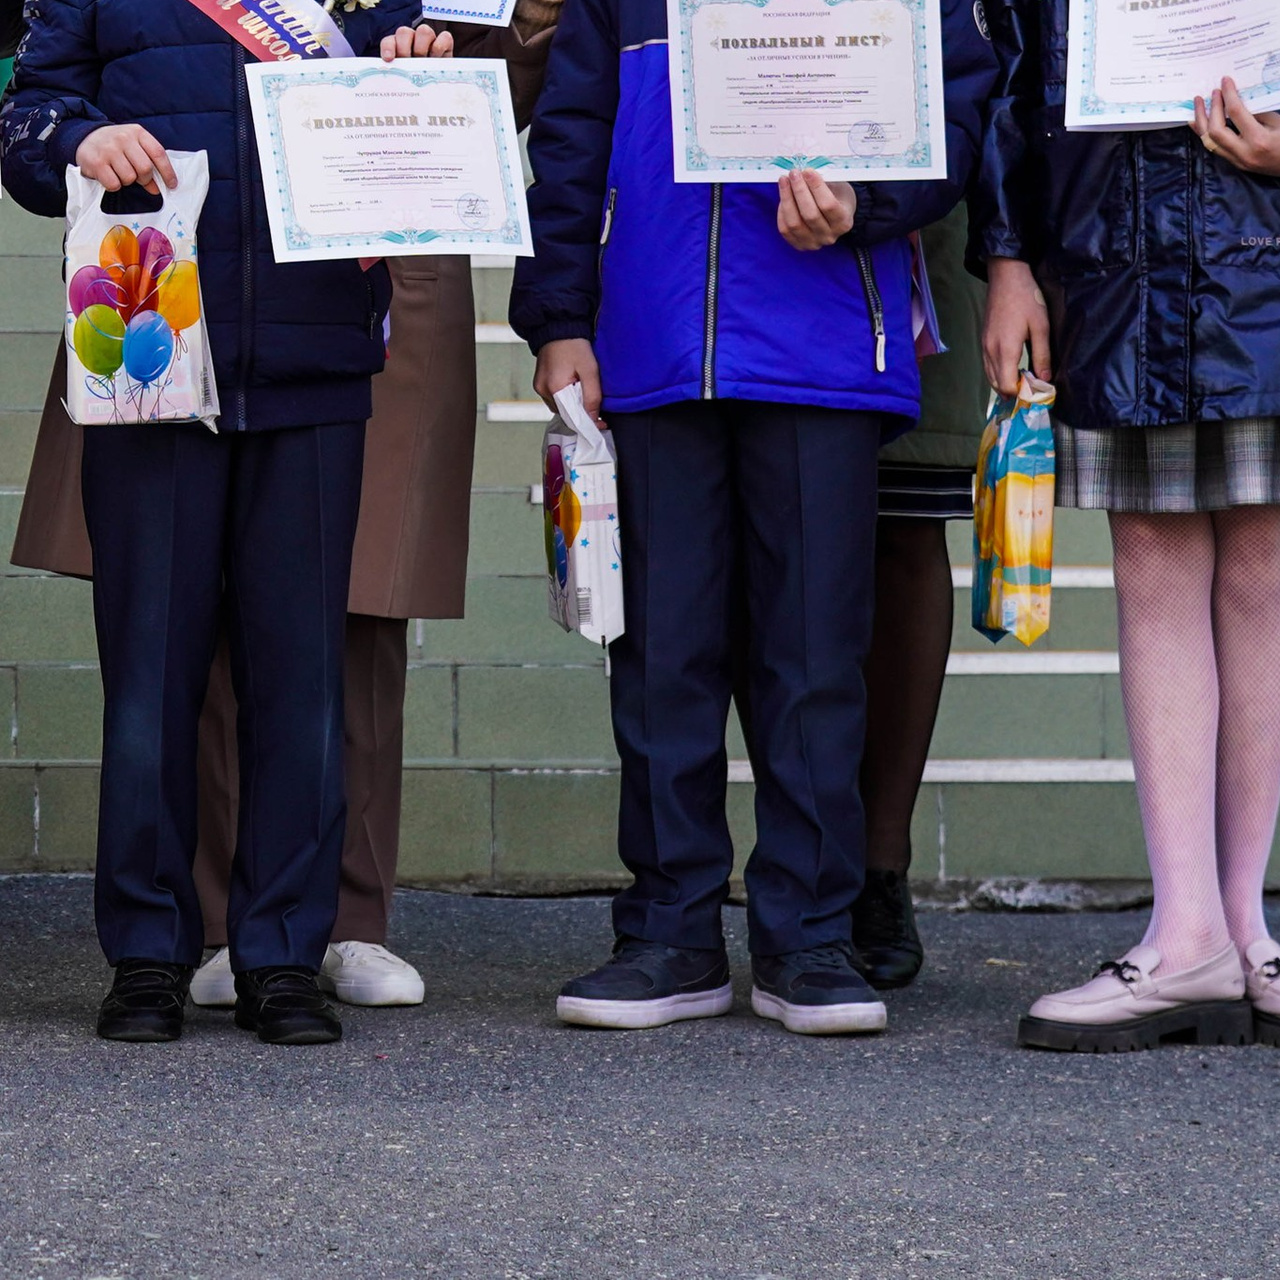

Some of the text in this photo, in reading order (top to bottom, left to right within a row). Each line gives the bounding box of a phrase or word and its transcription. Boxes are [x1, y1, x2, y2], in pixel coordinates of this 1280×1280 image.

[236, 9, 303, 62] школ
[721, 35, 882, 49] ПОХВАЛЬНЫЙ ЛИСТ
[314, 114, 467, 130] ПОХВАЛЬНЫЙ ЛИСТ
[1241, 236, 1274, 246] LOVE
